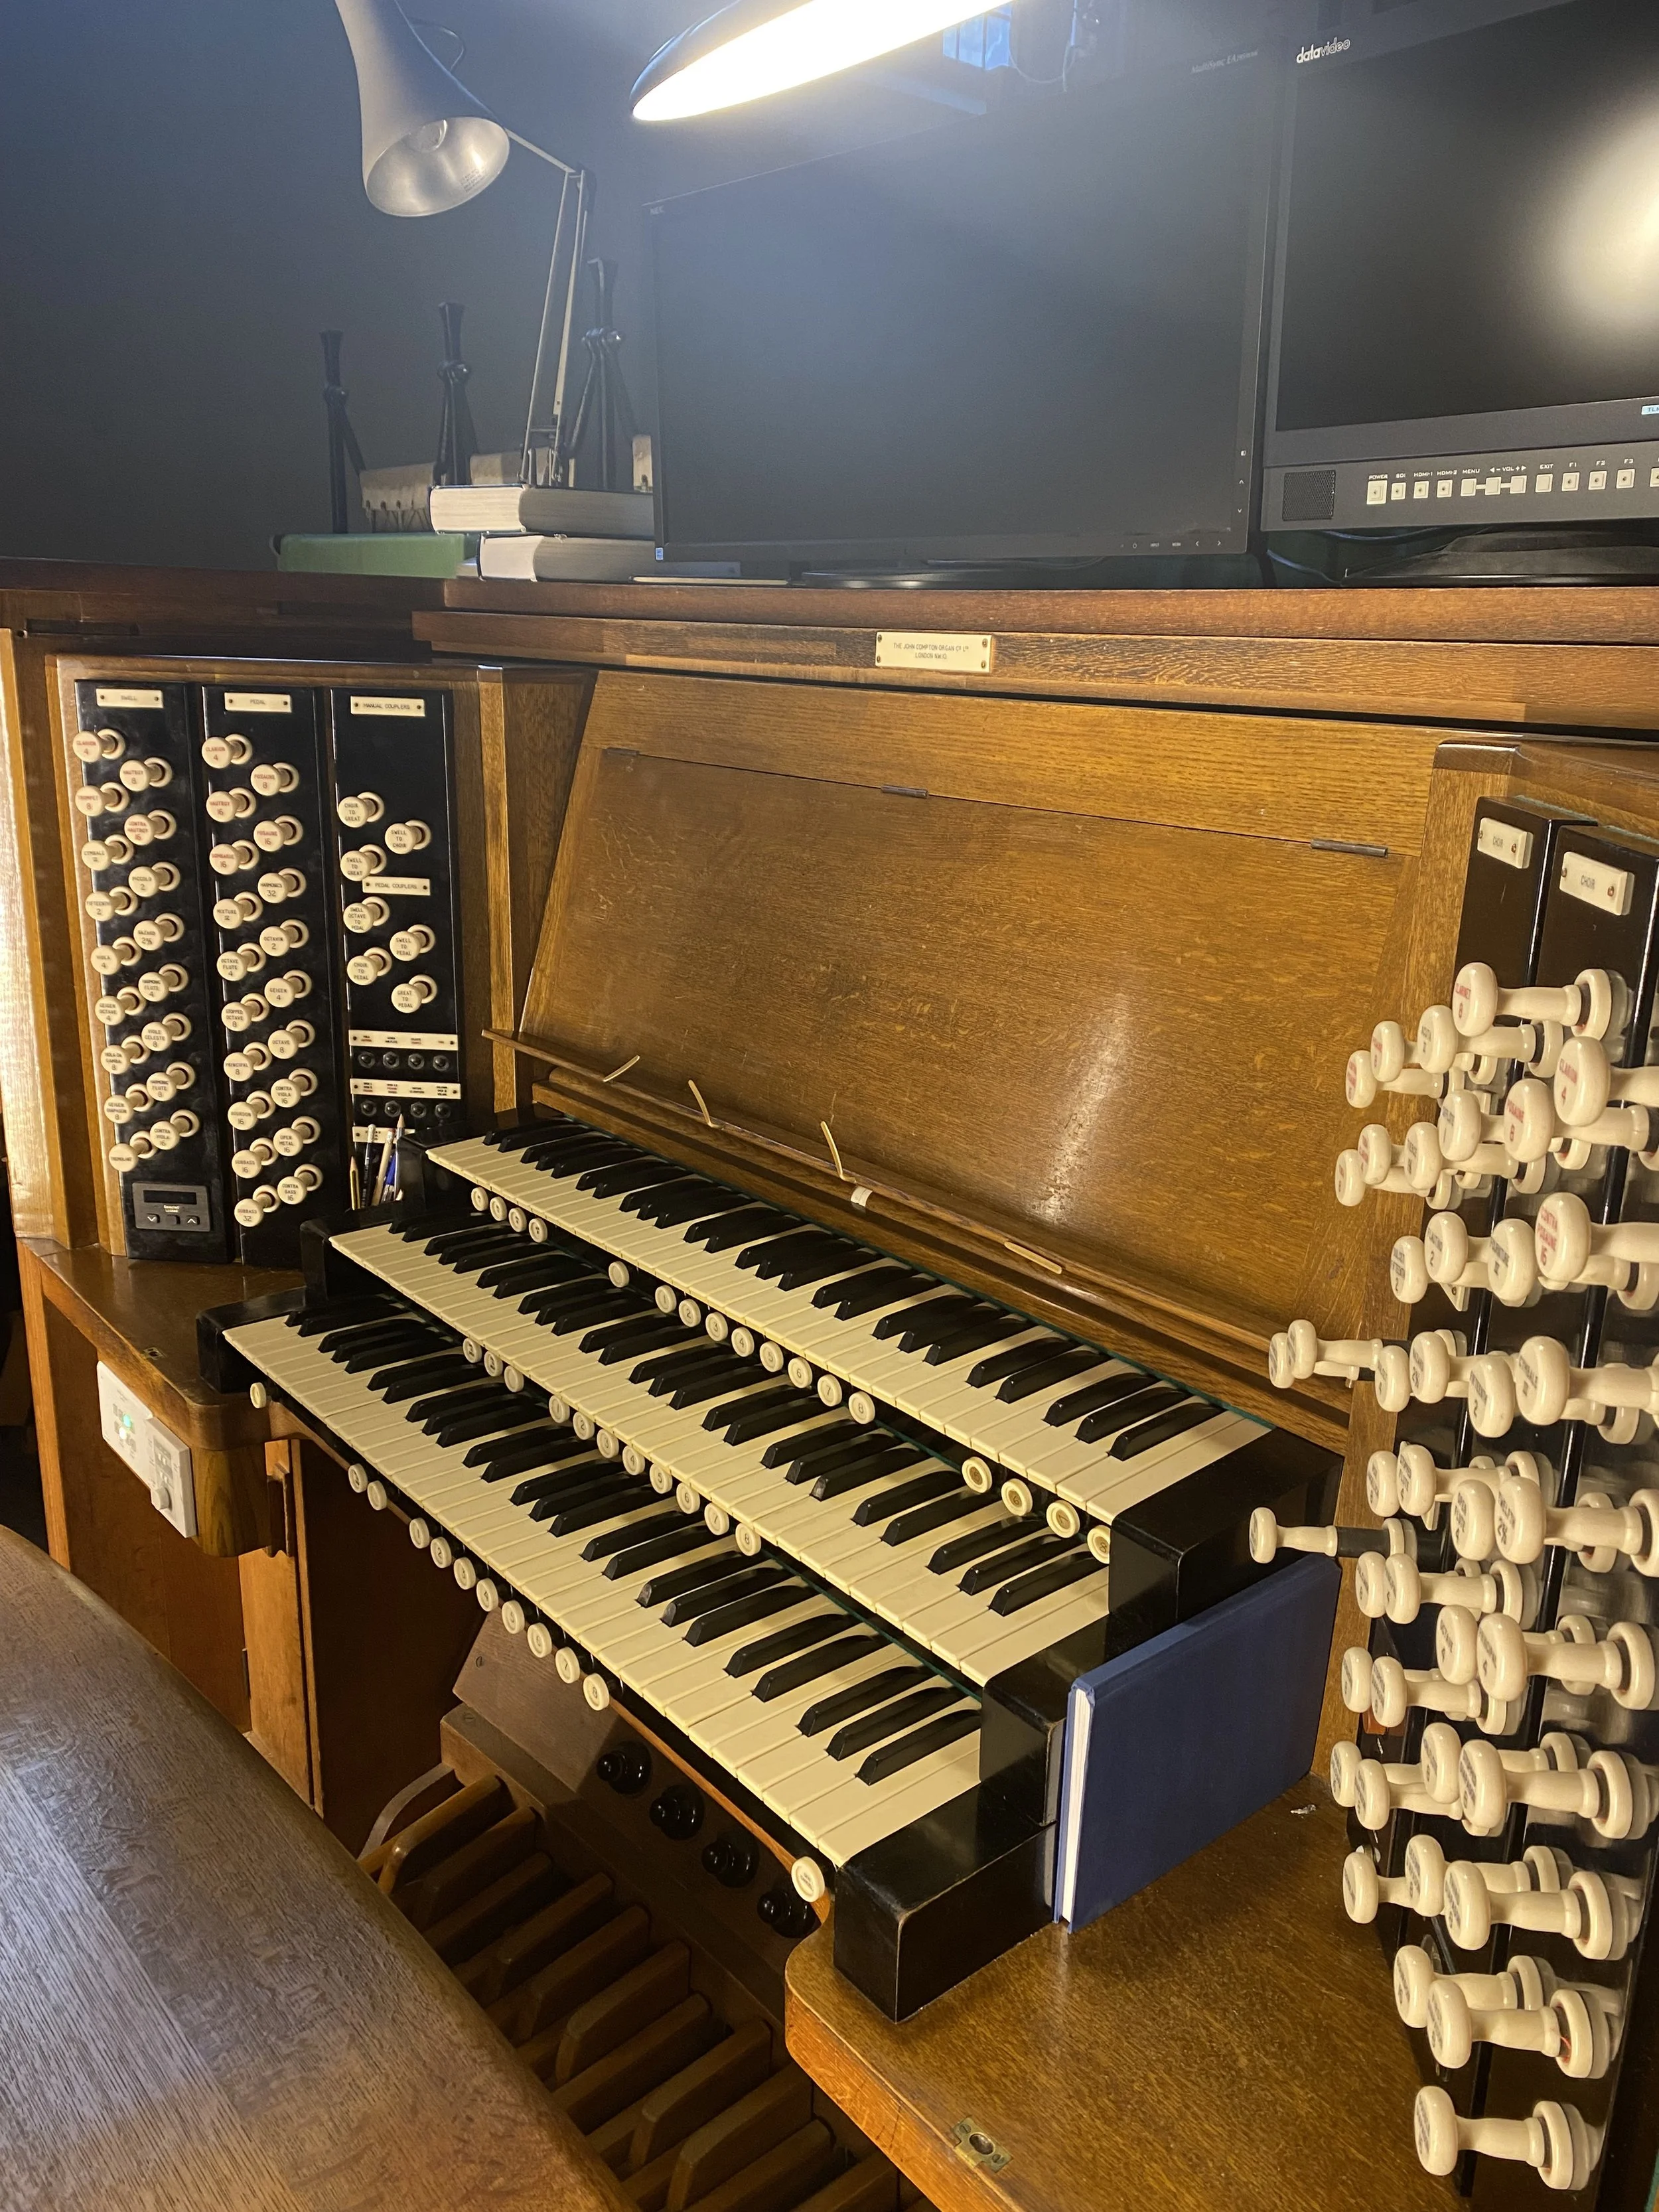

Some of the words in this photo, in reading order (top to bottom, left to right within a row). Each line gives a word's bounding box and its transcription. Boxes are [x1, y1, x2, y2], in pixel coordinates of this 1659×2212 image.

[1296, 37, 1350, 63] datavideo
[1492, 835, 1503, 848] CHOIR
[1581, 874, 1595, 891] CHOIR
[1458, 1003, 1463, 1019] 8
[1559, 1058, 1578, 1086] CLARION
[1561, 1086, 1567, 1106] 4
[1509, 1124, 1515, 1142] 8
[1541, 1205, 1558, 1230] CONTRA
[1429, 1250, 1435, 1267] 2
[1395, 1278, 1400, 1291] 2
[686, 1308, 691, 1319] 2
[713, 1321, 719, 1332] 3
[739, 1337, 745, 1349] 4
[768, 1351, 774, 1362] 5
[796, 1368, 802, 1379] 6
[825, 1384, 831, 1396] 7
[857, 1402, 864, 1414] 8
[1473, 1398, 1479, 1418] 2
[579, 1419, 586, 1431] 2
[605, 1438, 610, 1448] 3
[630, 1455, 635, 1467] 4
[658, 1472, 663, 1483] 5
[684, 1492, 690, 1503] 6
[1013, 1495, 1019, 1506] 6
[744, 1532, 750, 1545] 8
[437, 1546, 443, 1556] 2
[1099, 1541, 1108, 1554] 8
[592, 1686, 598, 1699] 8
